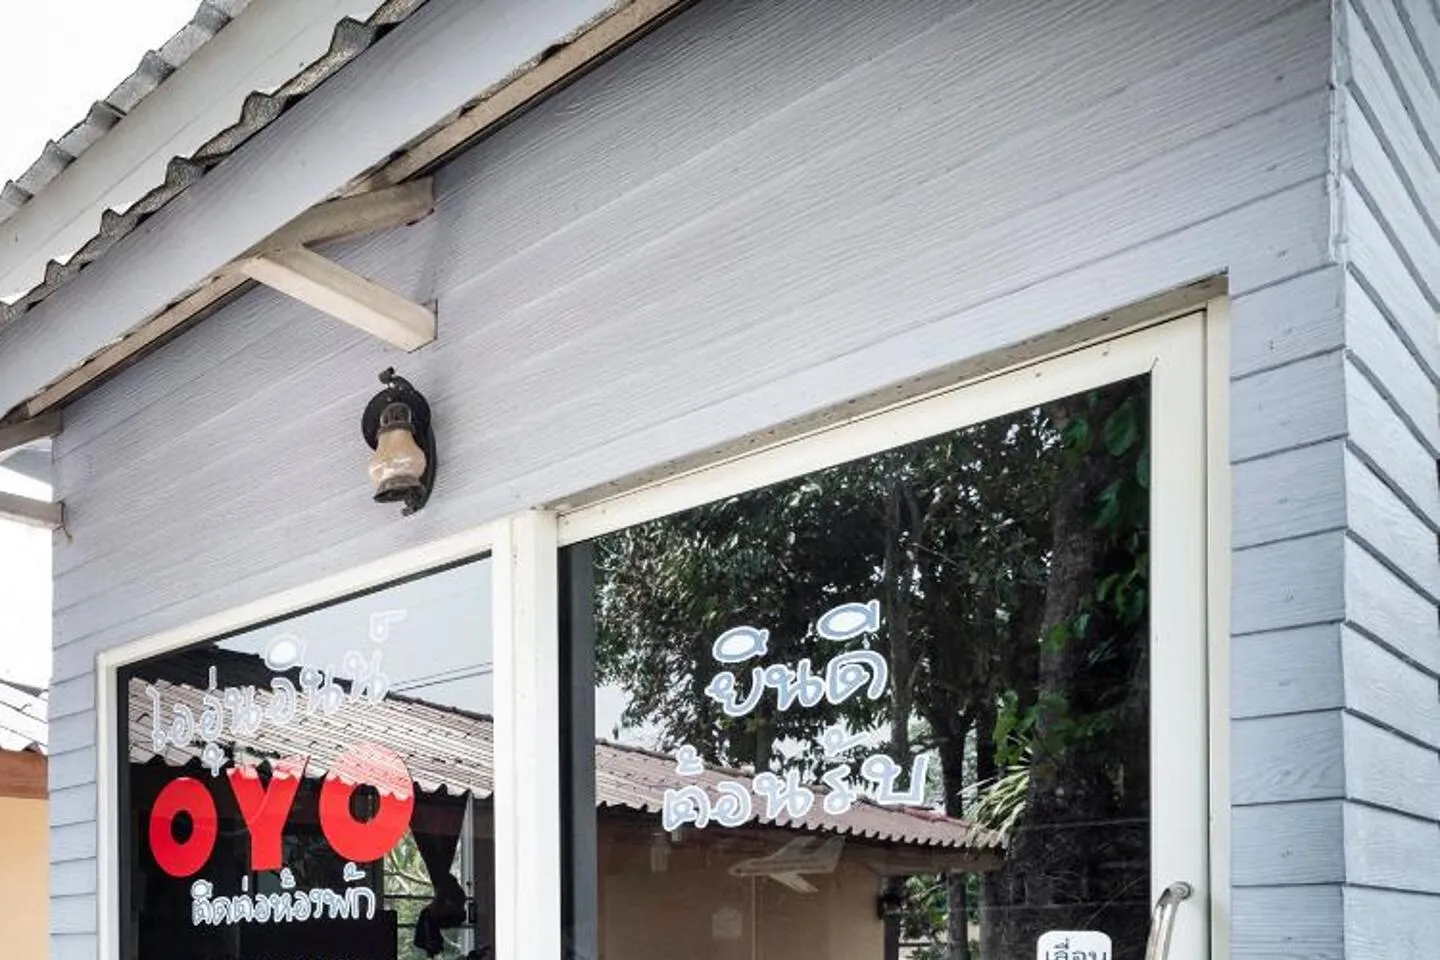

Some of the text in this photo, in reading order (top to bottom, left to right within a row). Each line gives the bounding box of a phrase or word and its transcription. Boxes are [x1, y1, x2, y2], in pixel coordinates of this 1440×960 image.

[704, 599, 888, 717] ยินดี
[148, 740, 415, 878] OYO
[663, 727, 930, 832] ต้อนรับ
[191, 861, 376, 926] ติดต่อห้องพัก
